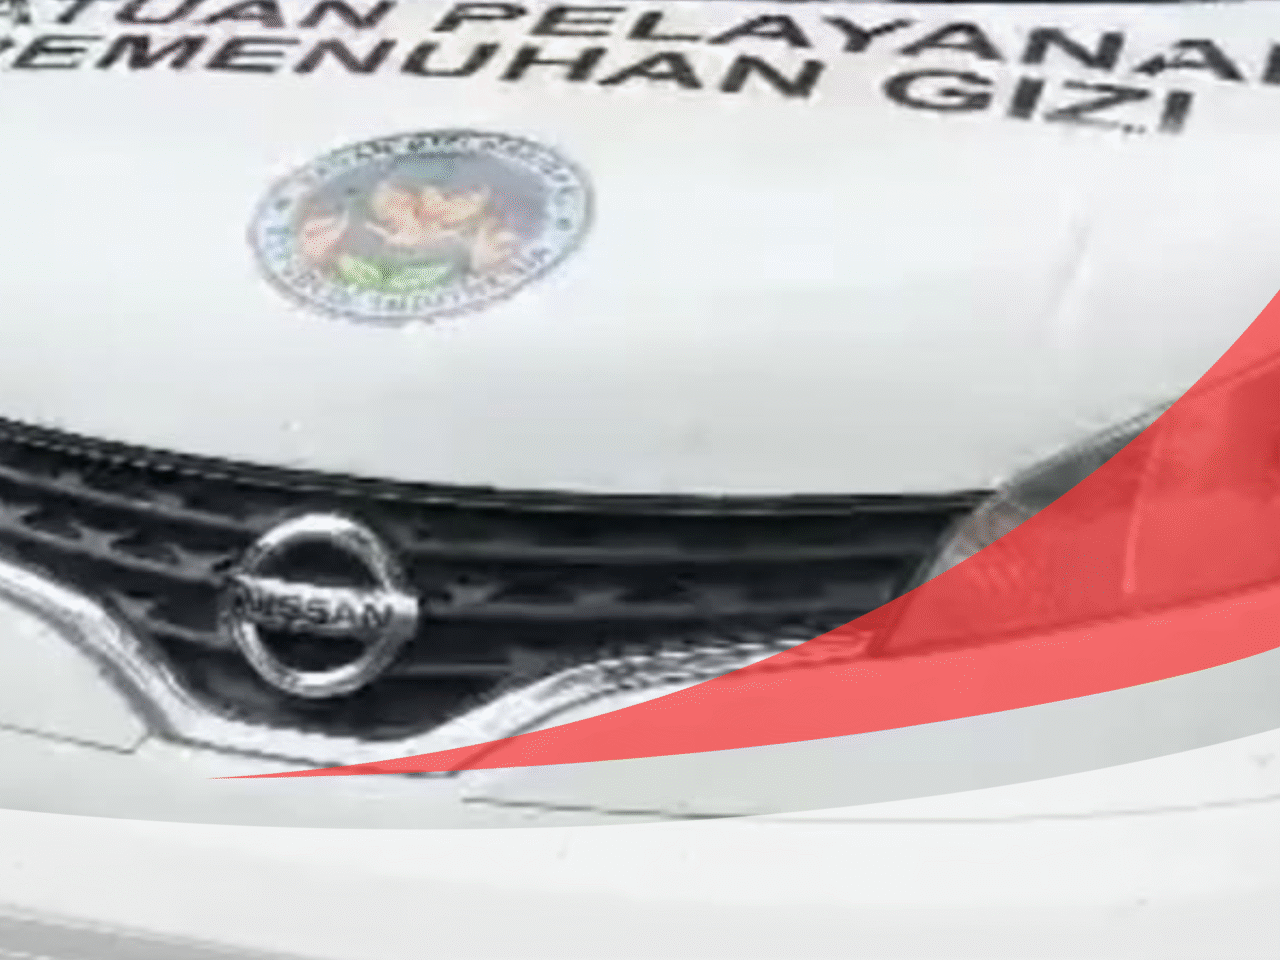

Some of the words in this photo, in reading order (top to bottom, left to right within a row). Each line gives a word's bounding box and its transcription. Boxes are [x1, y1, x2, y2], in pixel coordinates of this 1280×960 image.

[432, 2, 1280, 85] PELAYANA
[882, 68, 1195, 134] GIZI
[234, 585, 394, 628] NISSAN
